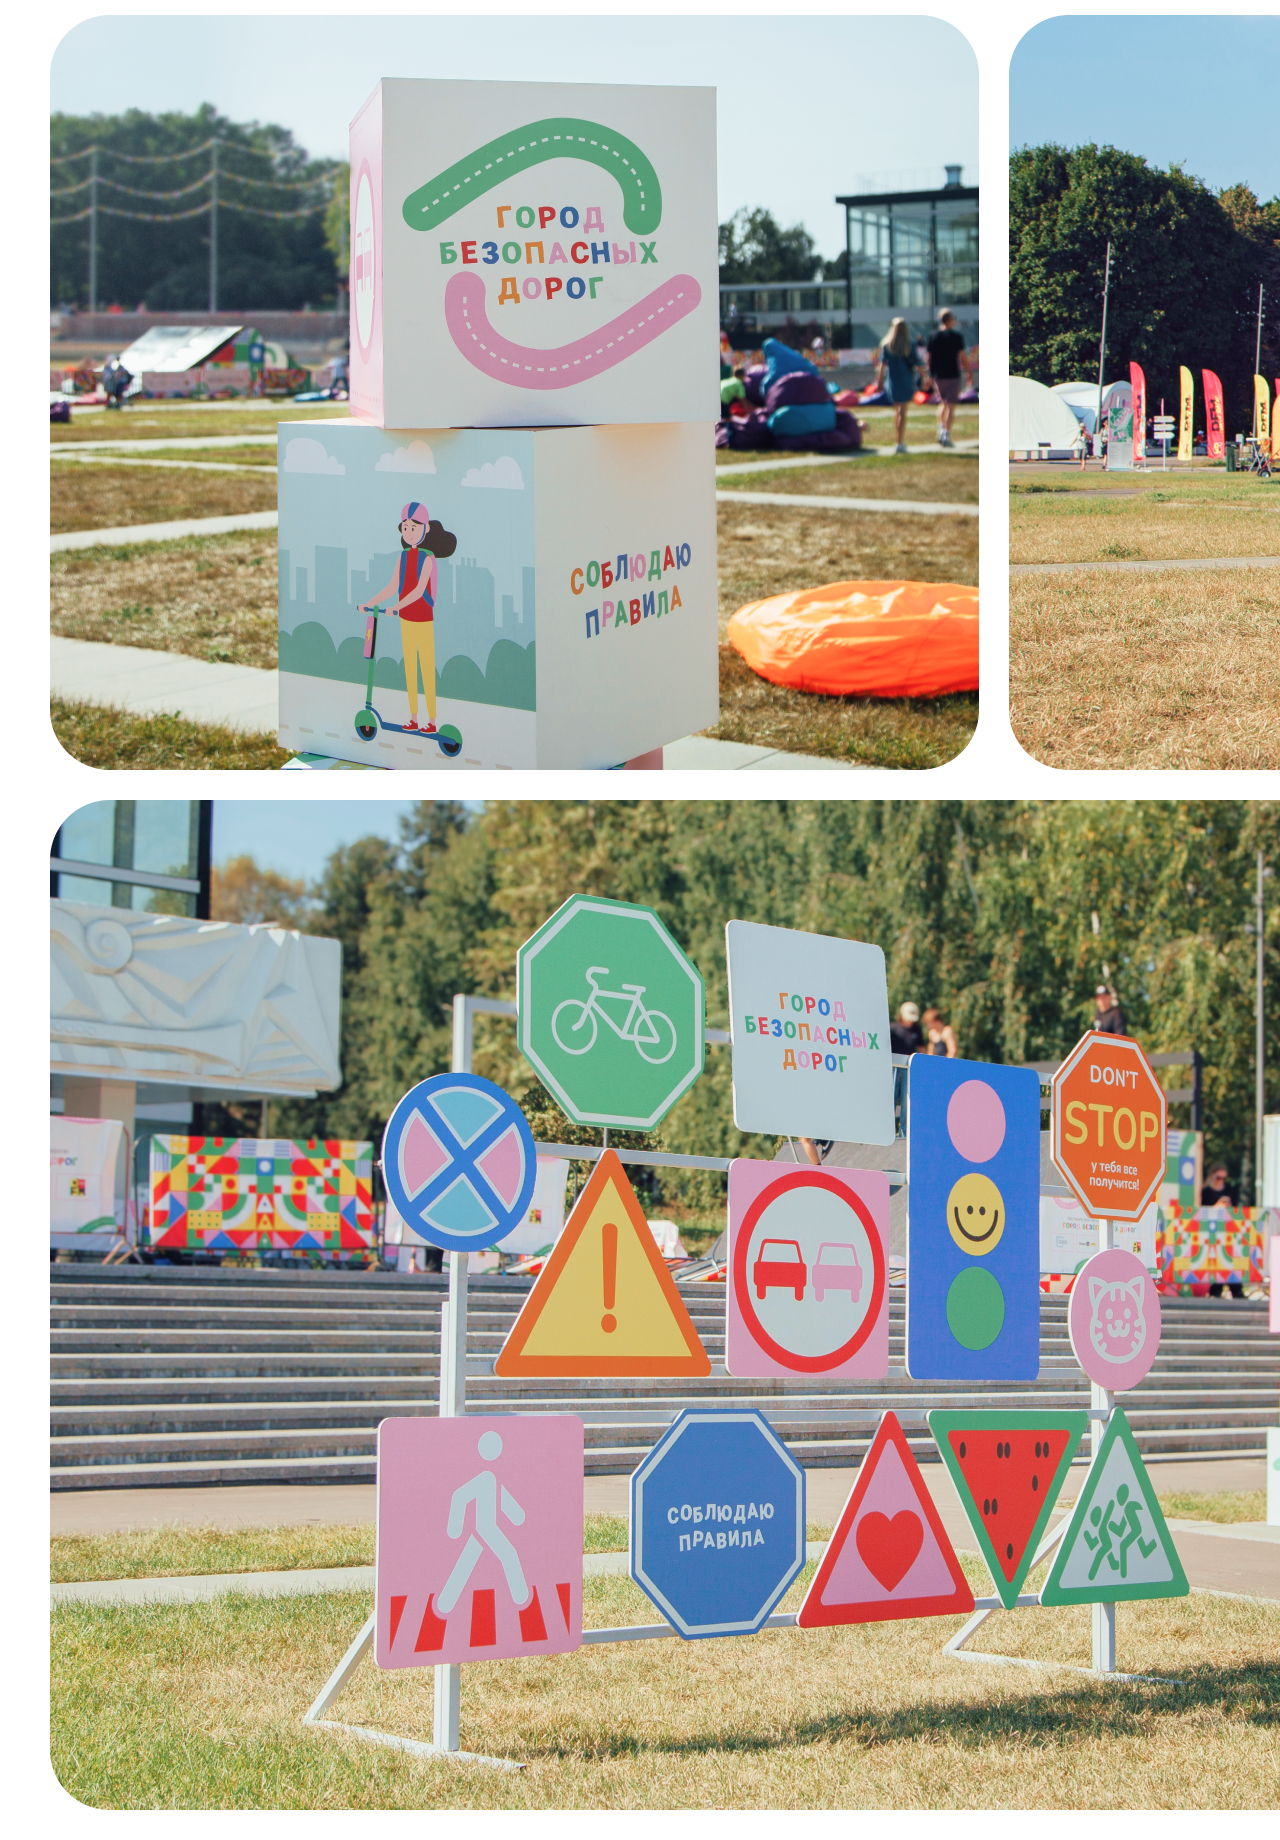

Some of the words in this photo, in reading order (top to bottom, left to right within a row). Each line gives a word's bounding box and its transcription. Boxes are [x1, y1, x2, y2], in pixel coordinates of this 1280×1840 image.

[496, 205, 605, 234] ГОРОД
[439, 240, 659, 266] БЕЗОПАСНЫХ
[498, 276, 604, 305] ДОРОГ
[571, 542, 692, 595] СОБЛЮДАЮ
[586, 585, 682, 638] ПРАВИЛА
[779, 992, 846, 1022] ГОРОД
[744, 1015, 880, 1050] БЕЗОПАСНЫХ
[783, 1049, 847, 1073] ДОРОГ
[1090, 1064, 1139, 1089] DON'T
[1065, 1100, 1159, 1152] STOP
[1091, 1162, 1097, 1173] у
[1099, 1160, 1122, 1174] тебя
[1123, 1165, 1138, 1175] все
[1089, 1177, 1140, 1191] получится!
[1062, 1222, 1081, 1231] ГОРОД
[1120, 1225, 1137, 1234] ДОРОГ
[667, 1502, 775, 1524] СОБЛЮДАЮ
[679, 1529, 765, 1551] ПРАВИЛА
